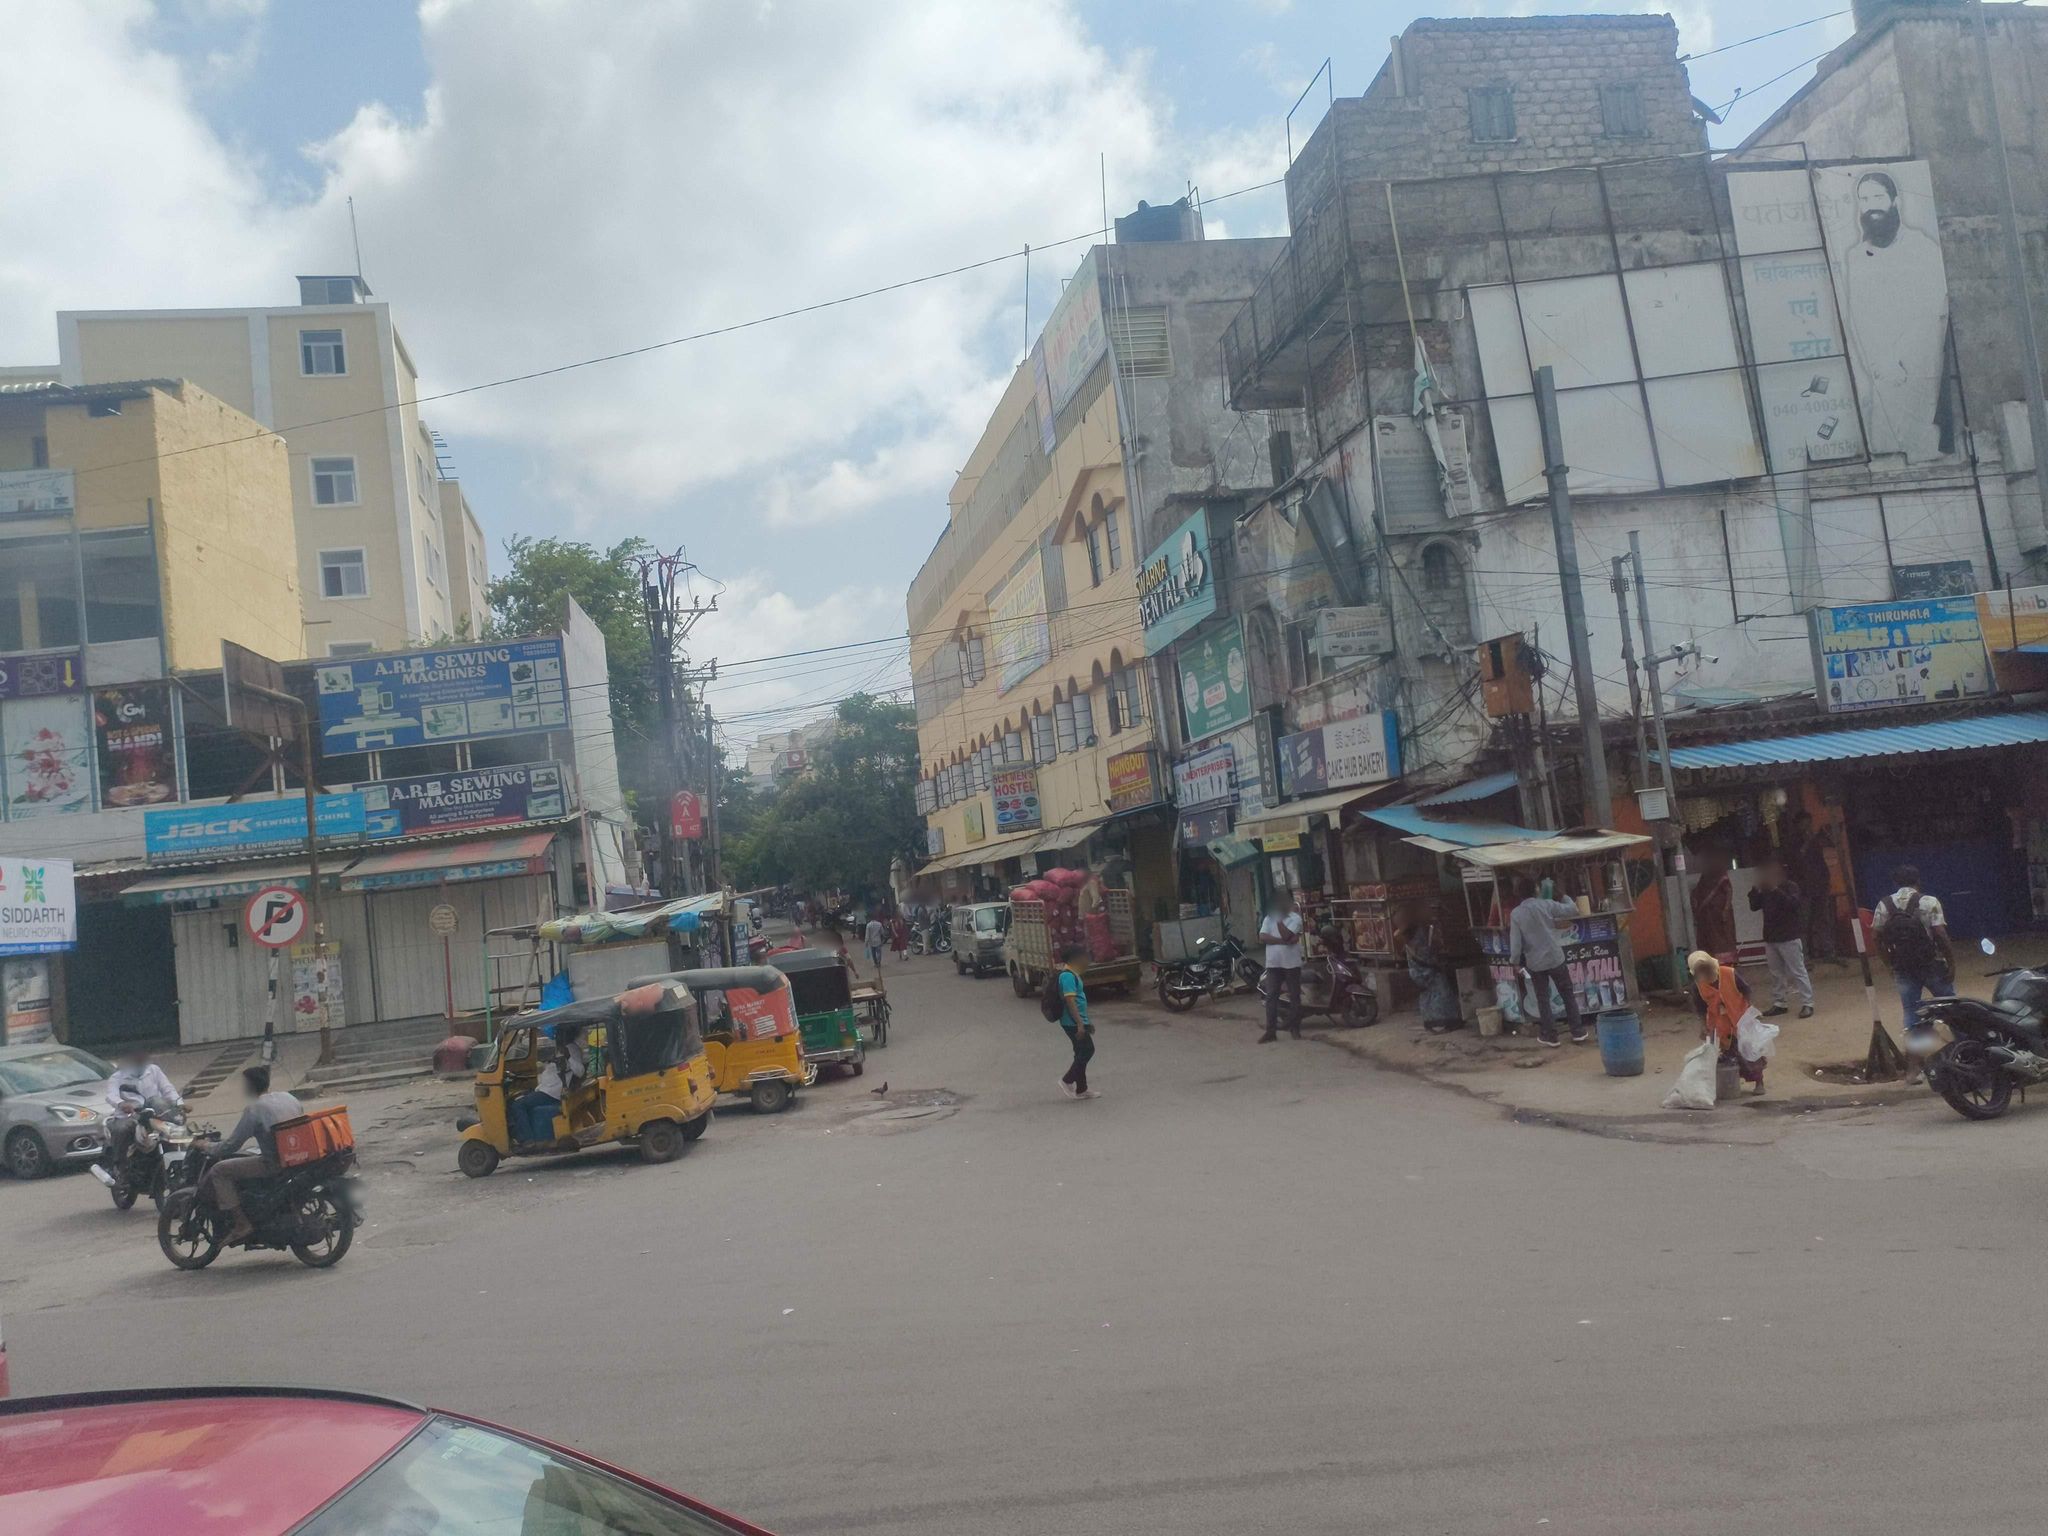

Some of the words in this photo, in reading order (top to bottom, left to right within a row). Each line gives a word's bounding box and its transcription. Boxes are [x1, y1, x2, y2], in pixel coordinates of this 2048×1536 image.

[1138, 575, 1182, 629] DENTAL
[1867, 608, 1931, 625] THIRUMALA
[435, 648, 511, 669] SEWING
[402, 666, 488, 685] MACHINES
[1327, 758, 1344, 782] CAKE
[1344, 755, 1358, 778] HUB
[1358, 750, 1385, 776] BAKERY
[450, 770, 527, 793] SEWING
[994, 780, 1037, 797] HOSTEL
[418, 787, 503, 810] MACHINES
[255, 816, 298, 828] SEWING
[300, 811, 352, 825] MCHINE
[164, 848, 198, 858] SEWING
[199, 844, 234, 855] MACHINE
[246, 838, 303, 850] ENTERPRISES
[162, 883, 252, 901] CAPITAL
[2, 906, 66, 924] SIDDARTH
[3, 927, 31, 938] NEURO
[32, 925, 67, 938] HOSPITAL
[1567, 961, 1585, 984] EA
[1586, 955, 1622, 982] STALL
